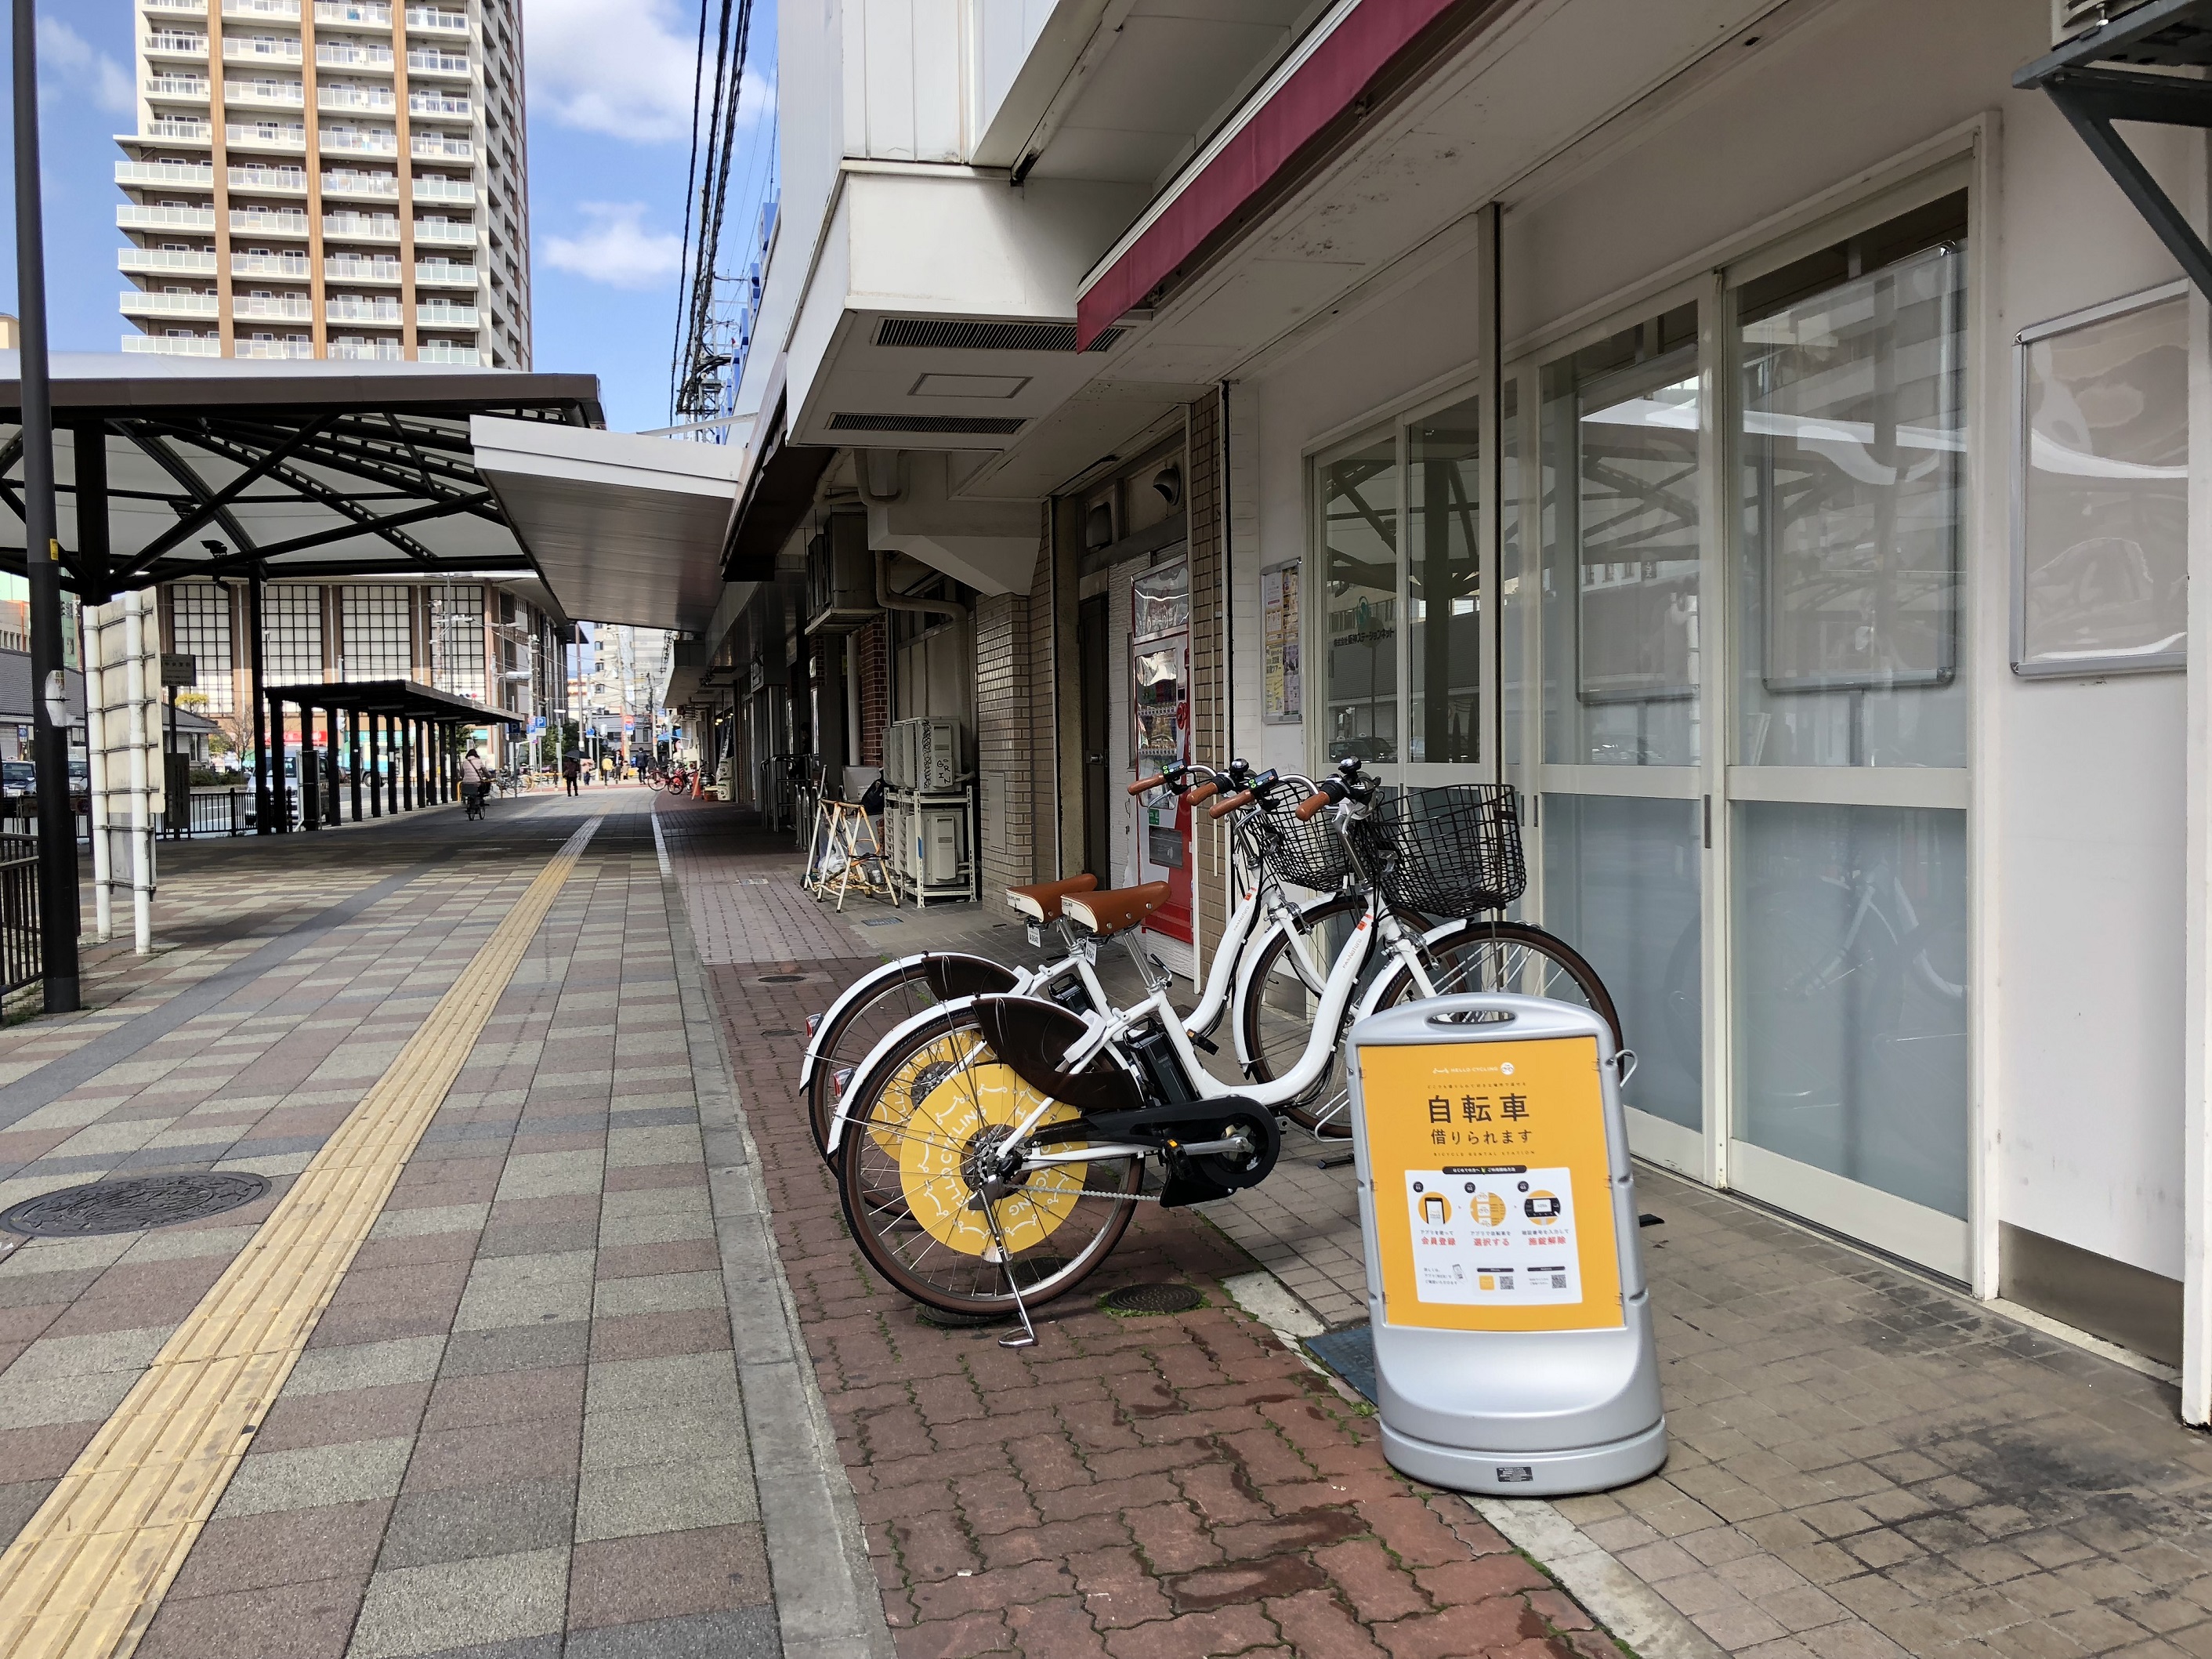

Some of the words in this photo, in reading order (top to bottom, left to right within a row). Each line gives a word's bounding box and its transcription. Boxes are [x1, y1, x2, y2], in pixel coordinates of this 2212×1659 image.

[1428, 1092, 1530, 1124] 自転車
[1431, 1128, 1533, 1145] 借りられます
[1421, 1237, 1456, 1246] 会員登録
[1474, 1237, 1510, 1246] 選択する
